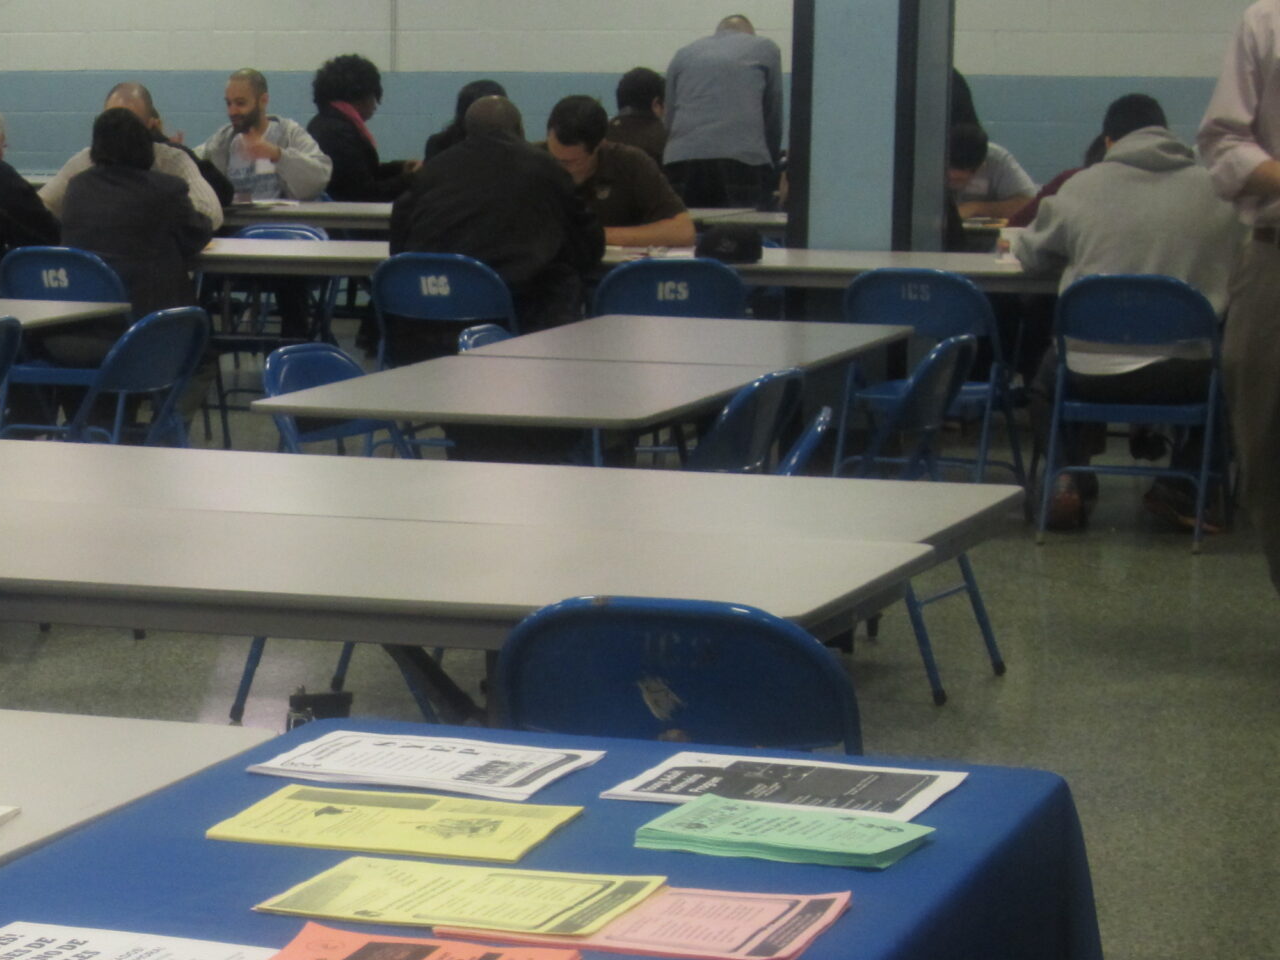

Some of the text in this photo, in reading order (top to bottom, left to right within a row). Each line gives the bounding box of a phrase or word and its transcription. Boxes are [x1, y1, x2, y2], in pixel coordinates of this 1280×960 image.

[42, 269, 68, 288] ICS
[657, 281, 688, 300] ICS
[21, 937, 60, 948] DE
[52, 938, 91, 950] DE
